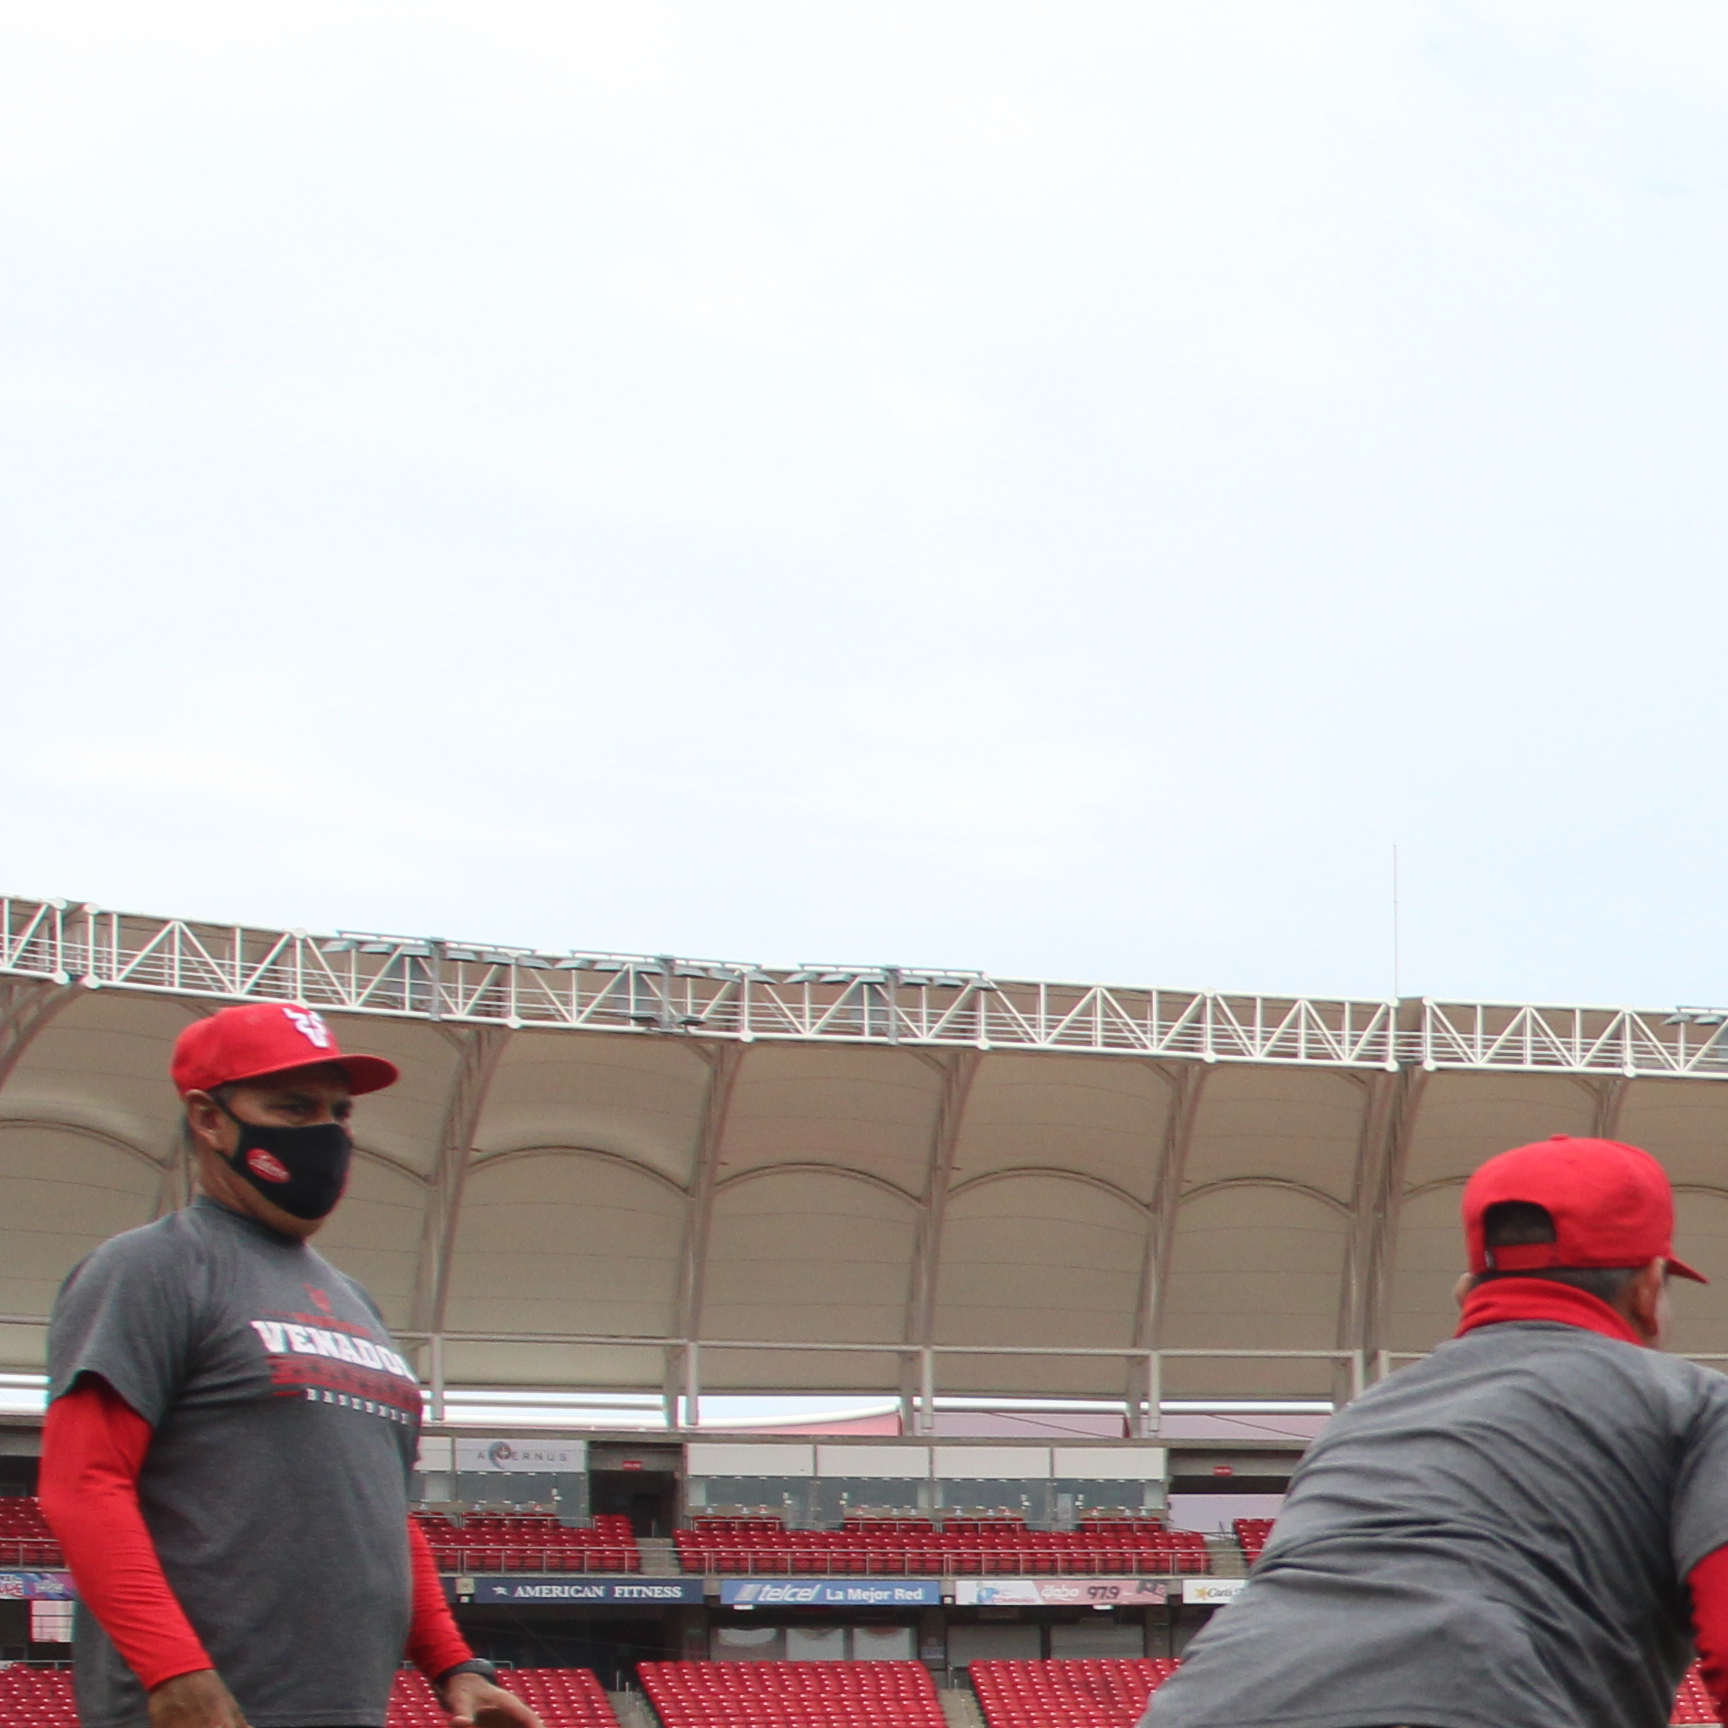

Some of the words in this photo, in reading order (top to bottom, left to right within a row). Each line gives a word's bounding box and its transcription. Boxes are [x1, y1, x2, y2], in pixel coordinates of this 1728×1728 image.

[514, 1586, 604, 1598] AMERICAN
[613, 1586, 682, 1598] FITNESS
[758, 1583, 822, 1601] telcel
[826, 1588, 838, 1600] La
[848, 1588, 891, 1603] Mejor
[894, 1587, 923, 1600] Red
